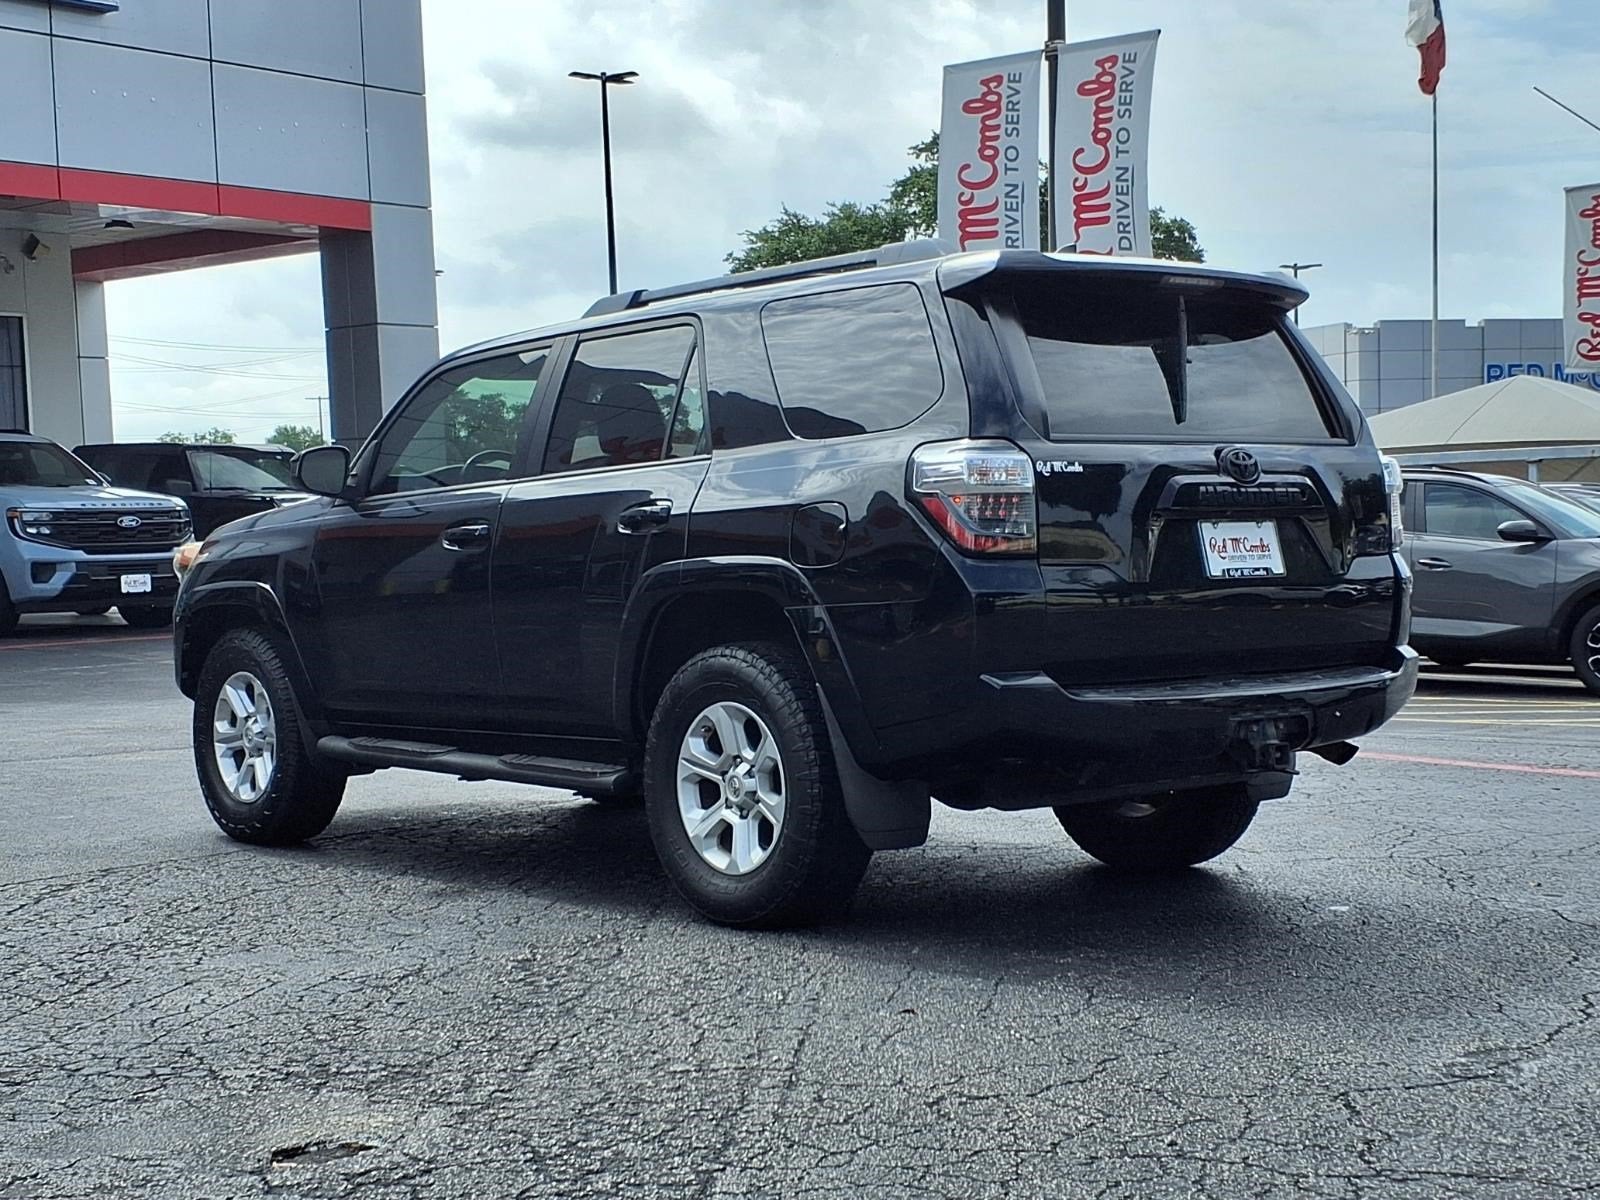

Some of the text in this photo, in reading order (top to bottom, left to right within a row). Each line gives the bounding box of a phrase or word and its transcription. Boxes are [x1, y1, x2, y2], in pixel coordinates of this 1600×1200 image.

[957, 74, 1004, 252] McCombs
[1004, 72, 1022, 249] RIVEN TO SERVE
[1072, 54, 1119, 243] McCombs
[1115, 52, 1137, 251] DRIVEN TO SERVE
[1209, 536, 1270, 560] Red McCombs
